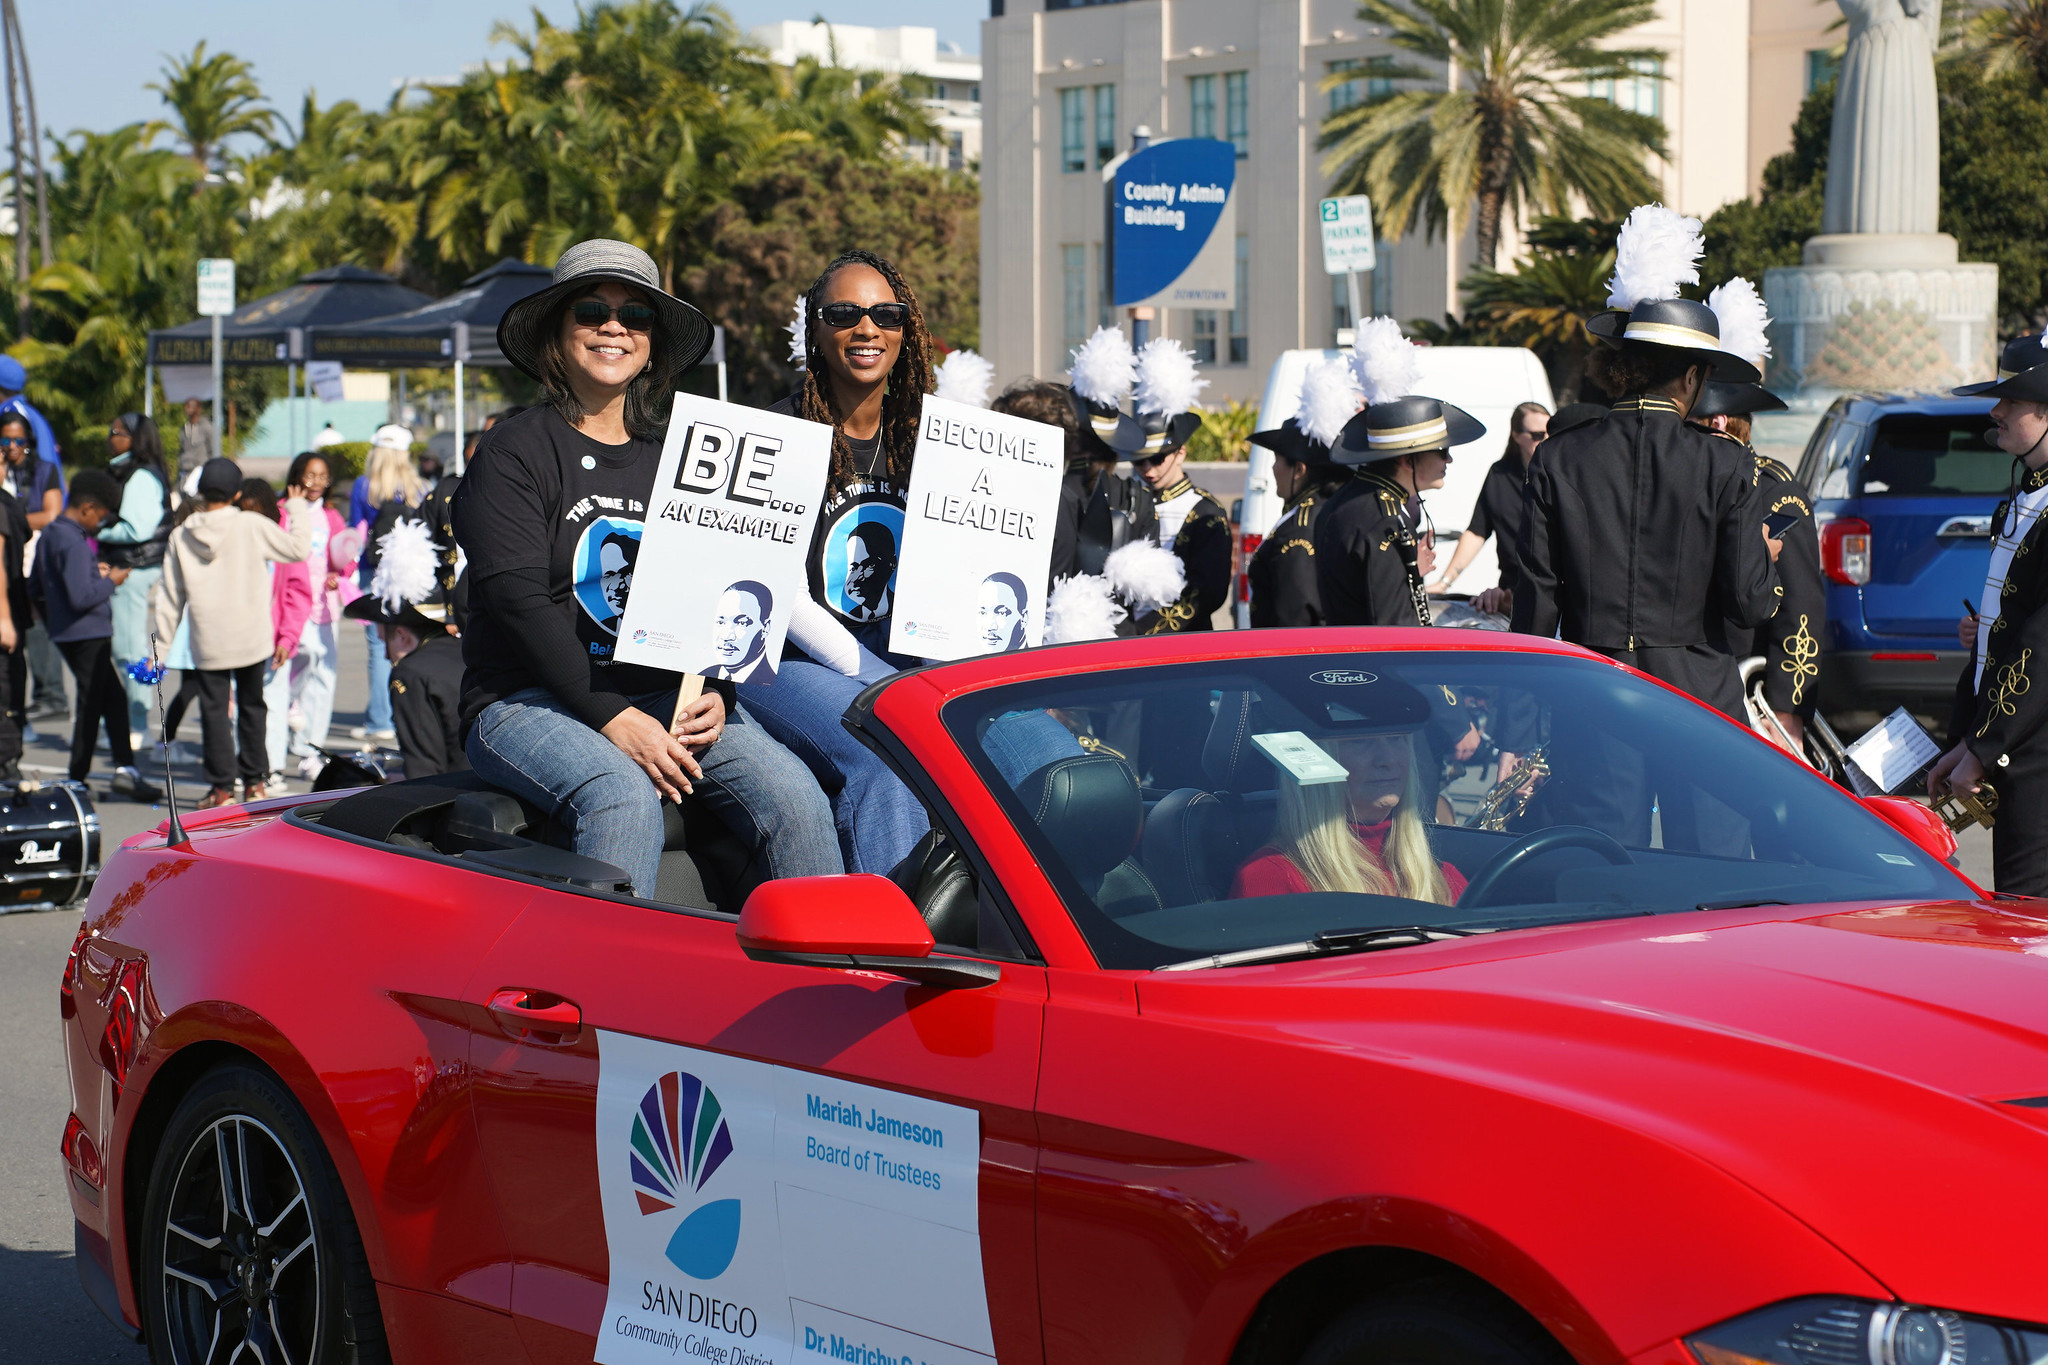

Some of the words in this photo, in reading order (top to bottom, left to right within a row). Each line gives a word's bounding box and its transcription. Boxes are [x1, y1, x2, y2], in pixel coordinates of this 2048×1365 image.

[1124, 181, 1176, 206] County
[1179, 183, 1226, 204] Admin
[1124, 206, 1185, 231] Building
[1323, 202, 1337, 220] 2
[1174, 289, 1227, 300] DOWNTOWN
[926, 414, 1056, 468] BECOME...
[673, 421, 806, 514] BE...
[971, 467, 994, 496] A
[880, 481, 892, 495] IS
[566, 498, 594, 522] THE
[628, 499, 644, 512] IS
[924, 491, 1039, 540] LEADER
[1771, 501, 1783, 513] EL
[1781, 495, 1810, 517] CAPITAN
[661, 500, 697, 524] AN
[698, 505, 800, 544] EXAMPLE
[1322, 672, 1367, 683] Ford
[806, 1093, 862, 1129] Mariah
[865, 1108, 943, 1149] Jameson
[807, 1135, 850, 1168] Board
[854, 1150, 870, 1172] of
[873, 1151, 941, 1191] Trustees
[642, 1280, 683, 1320] SAN
[688, 1292, 757, 1339] DIEGO
[616, 1315, 683, 1356] Community
[684, 1334, 728, 1365] College
[805, 1326, 827, 1355] Dr.
